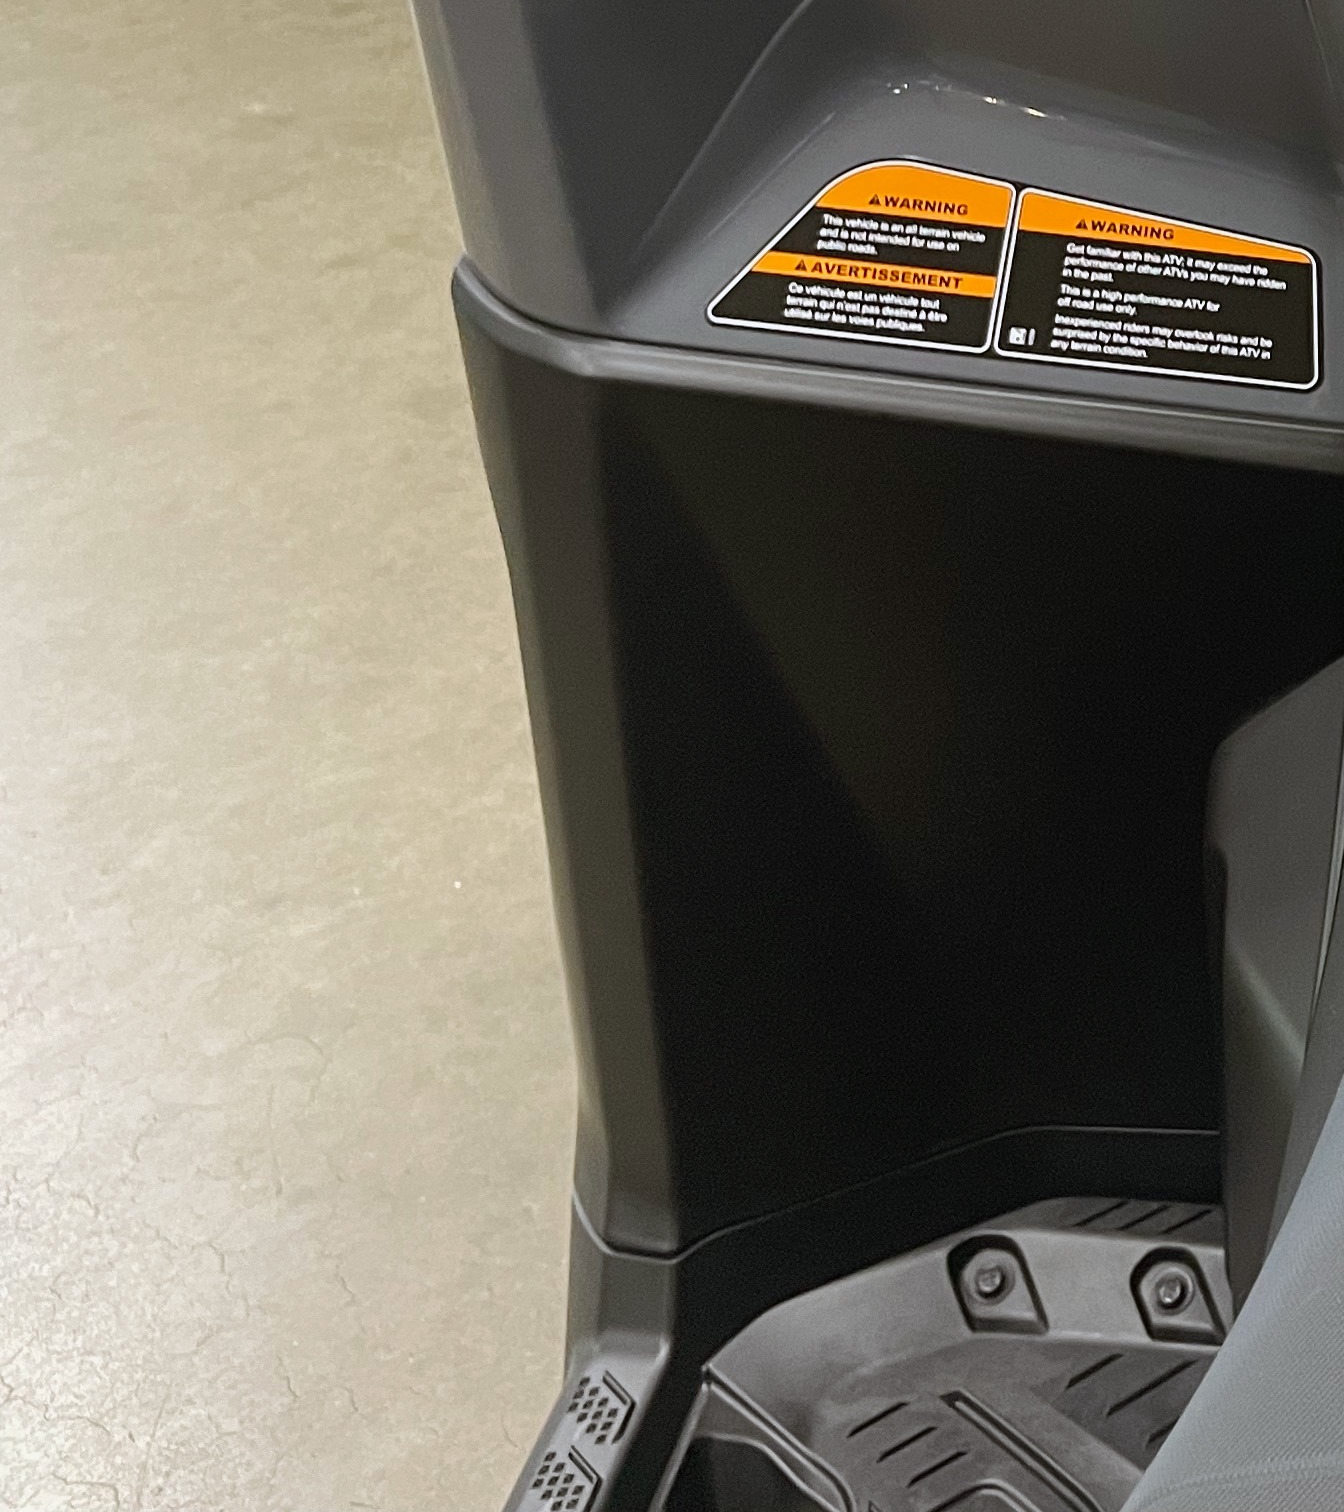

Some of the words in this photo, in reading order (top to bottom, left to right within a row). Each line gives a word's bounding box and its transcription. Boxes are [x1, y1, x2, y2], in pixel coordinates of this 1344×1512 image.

[885, 195, 969, 216] WARNING
[823, 214, 843, 226] This
[846, 218, 878, 230] vehicle
[952, 229, 986, 243] vehicle
[1092, 220, 1174, 240] WARNING
[811, 261, 964, 288] AVERTISSEMENT
